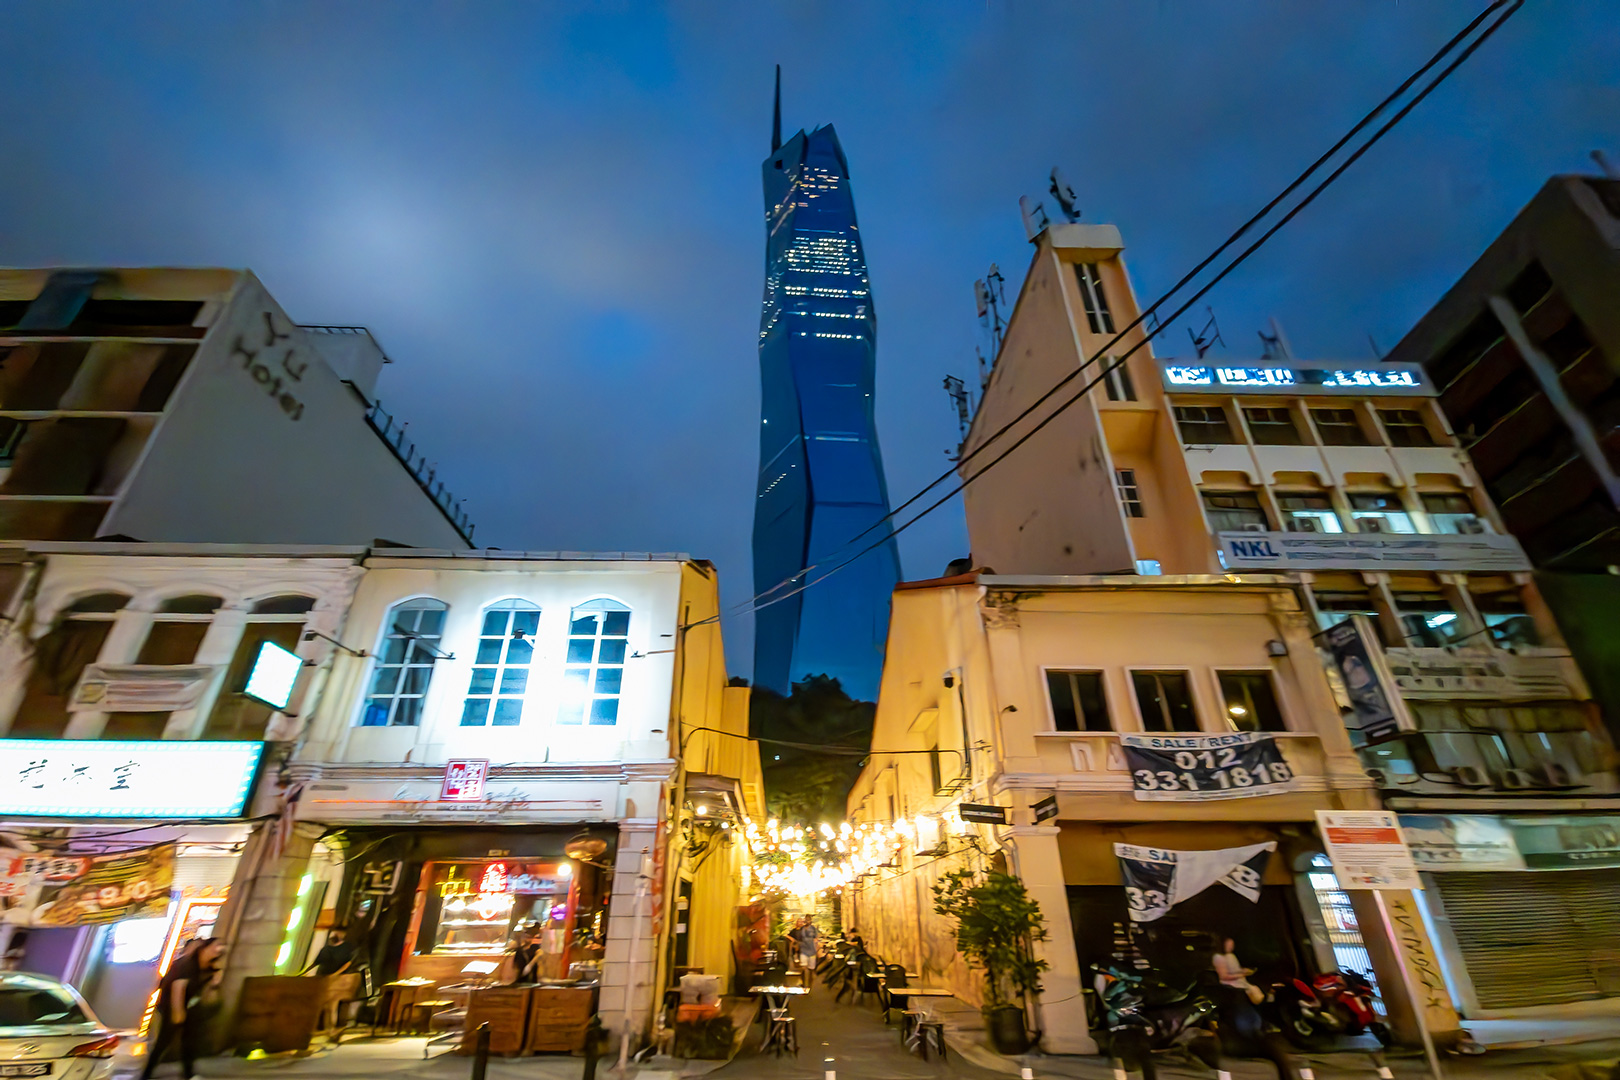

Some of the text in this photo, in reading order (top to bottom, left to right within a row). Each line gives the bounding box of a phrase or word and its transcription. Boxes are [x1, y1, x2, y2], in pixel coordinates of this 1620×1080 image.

[1230, 541, 1281, 557] NKL
[1175, 748, 1243, 770] 012
[1134, 762, 1293, 791] 331 1818
